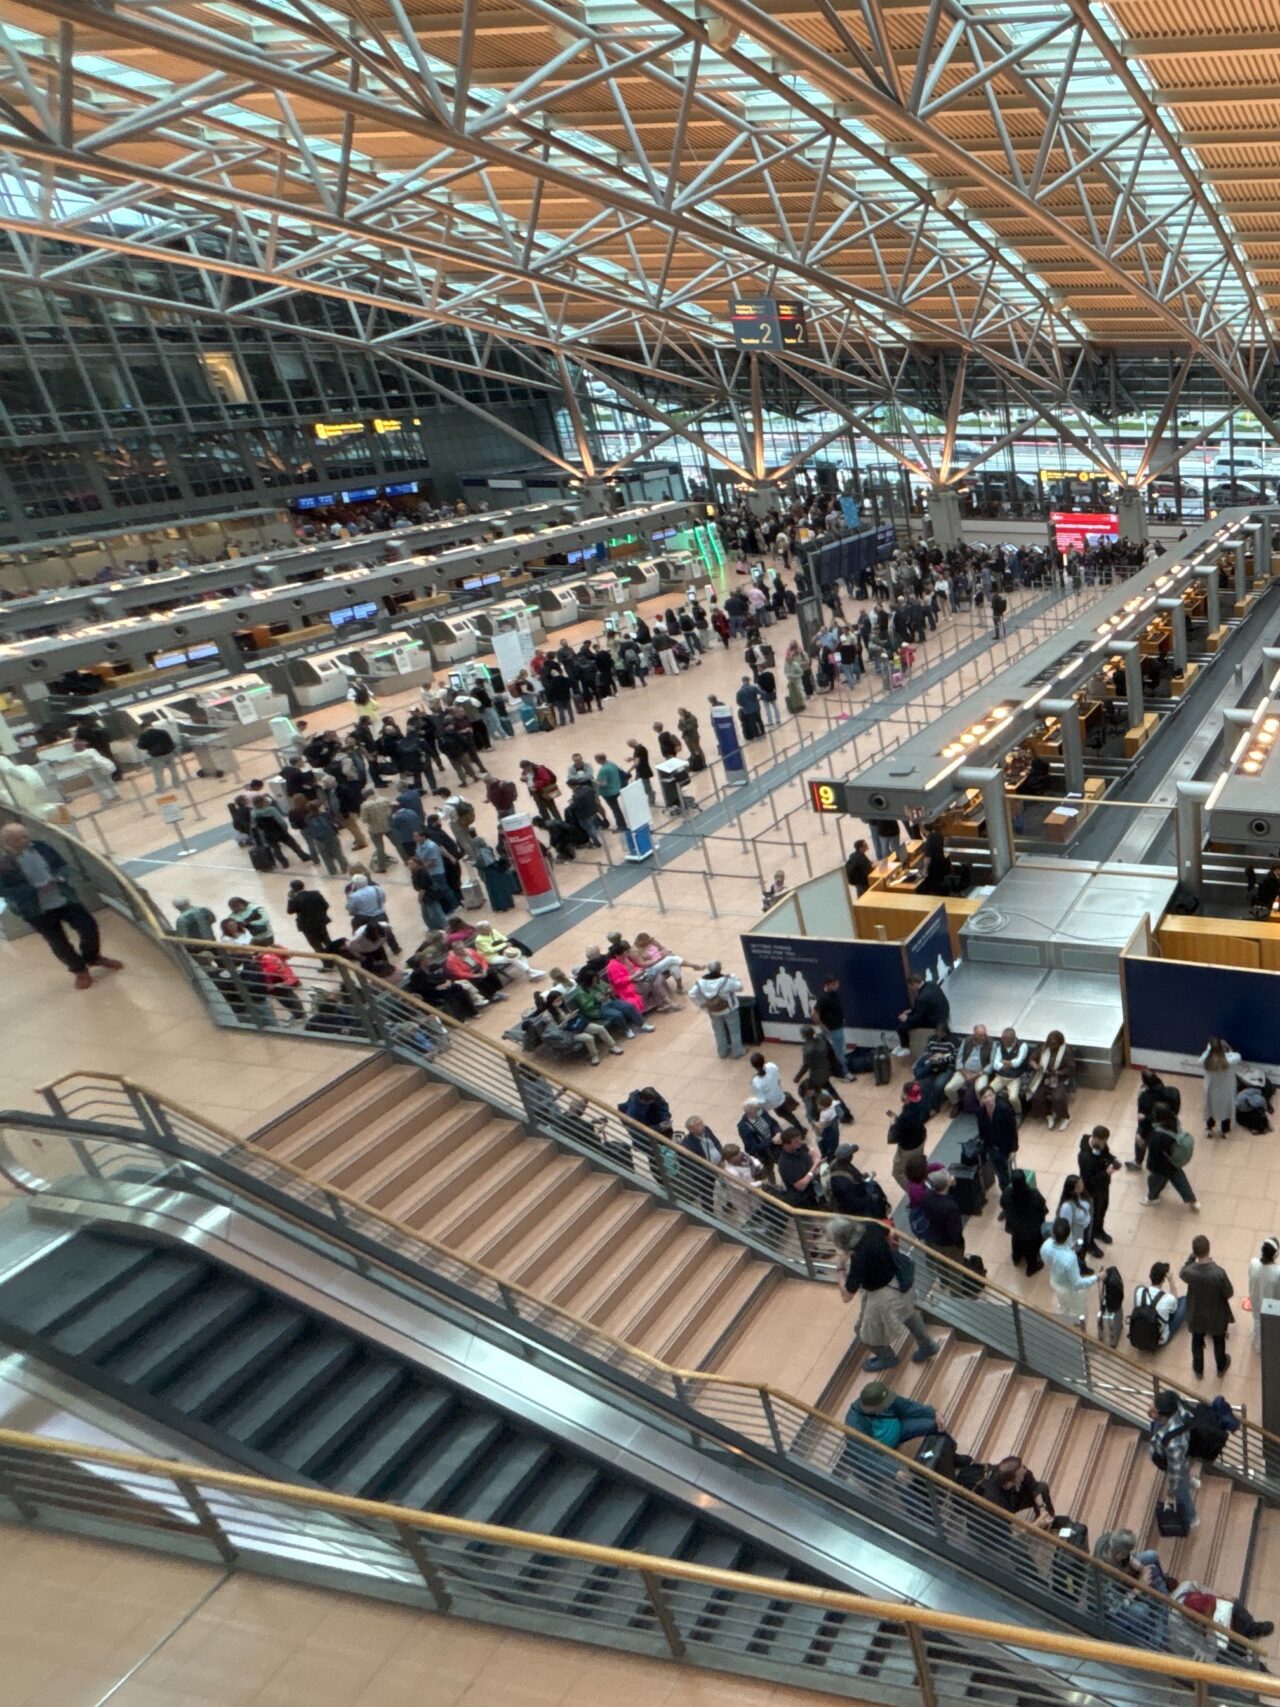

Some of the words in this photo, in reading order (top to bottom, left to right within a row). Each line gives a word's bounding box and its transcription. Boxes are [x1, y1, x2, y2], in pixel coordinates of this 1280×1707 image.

[760, 323, 773, 343] 2
[795, 323, 805, 343] 2
[819, 786, 834, 804] 9
